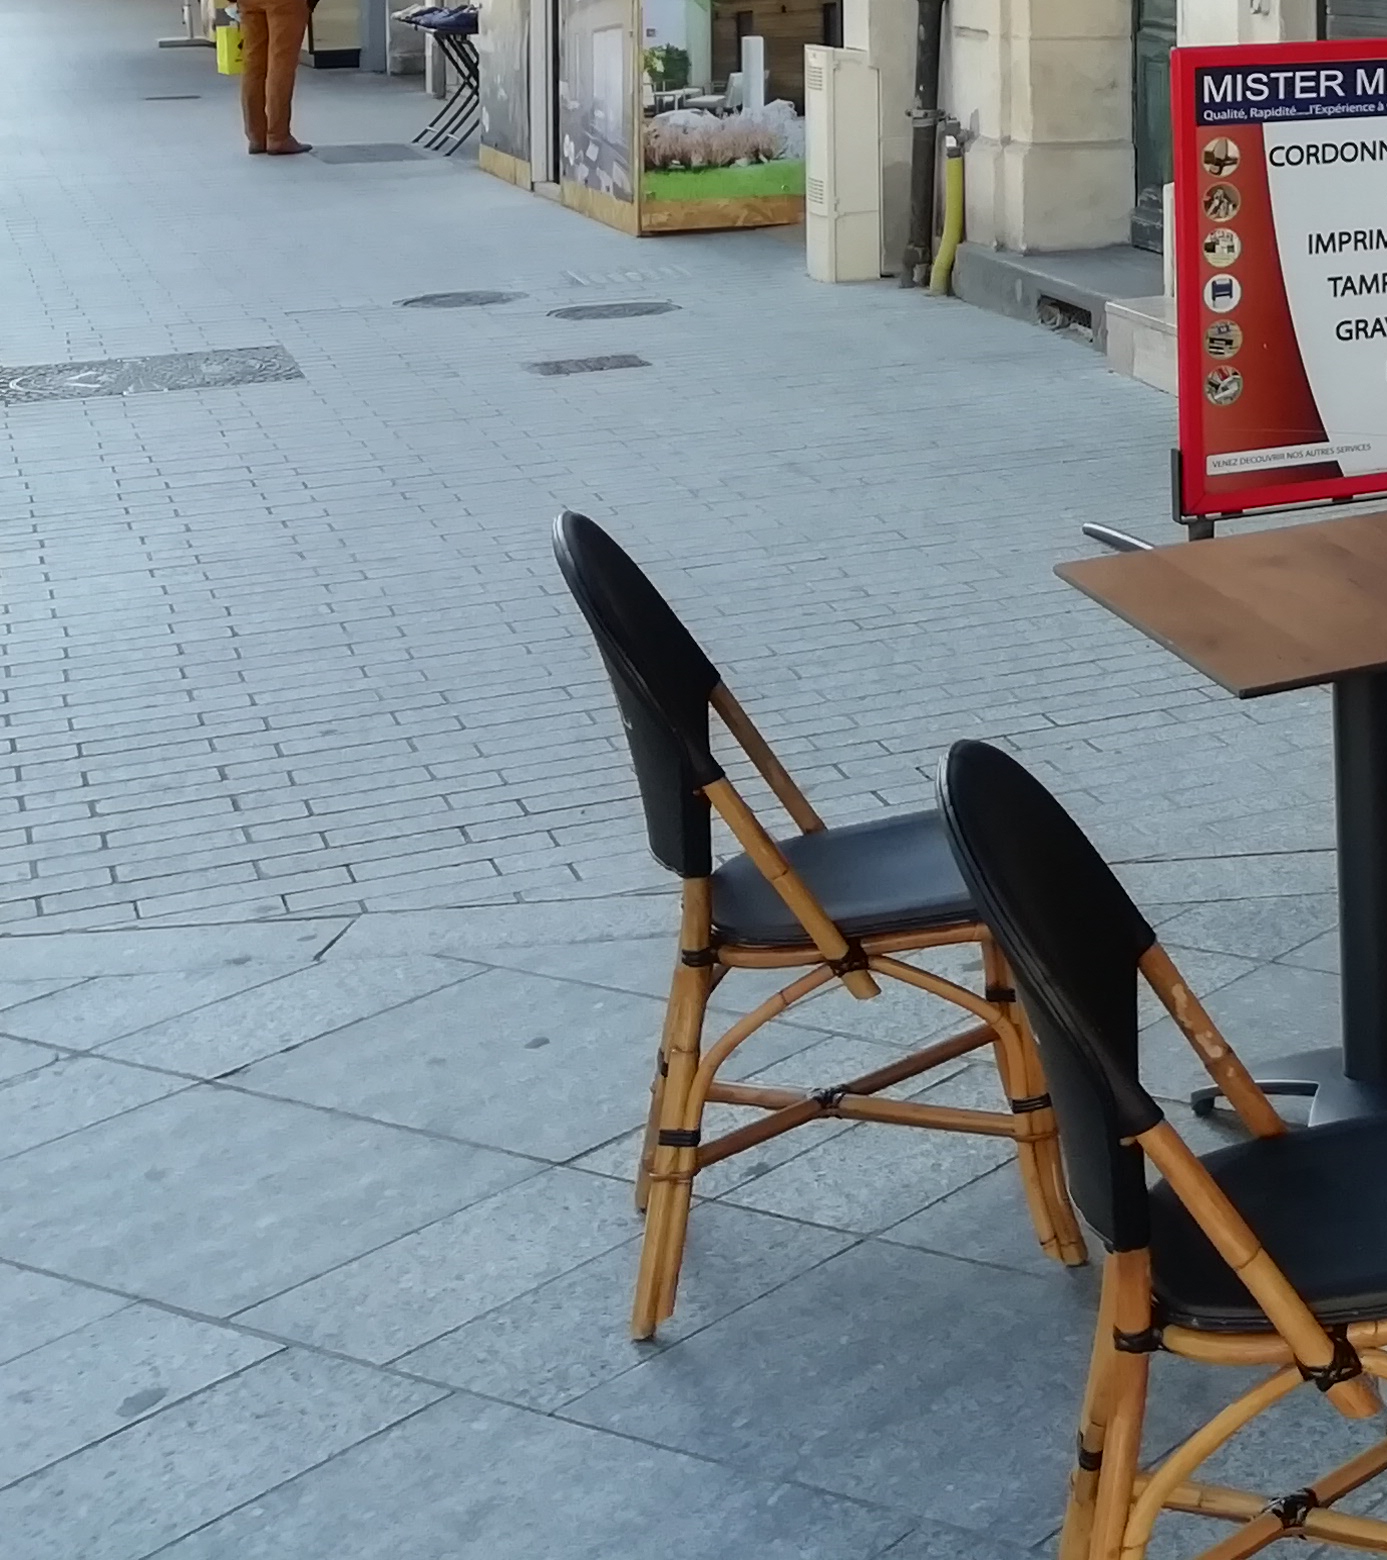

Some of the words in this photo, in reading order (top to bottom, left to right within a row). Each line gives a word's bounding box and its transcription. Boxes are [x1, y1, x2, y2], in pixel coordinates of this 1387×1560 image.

[1203, 69, 1346, 104] MISTER
[1203, 108, 1248, 121] Qualité,
[1376, 100, 1385, 112] à
[1212, 458, 1239, 468] VENEZ
[1286, 451, 1303, 460] NOS
[1305, 447, 1335, 458] AUTRES
[1336, 443, 1372, 455] SERVICES
